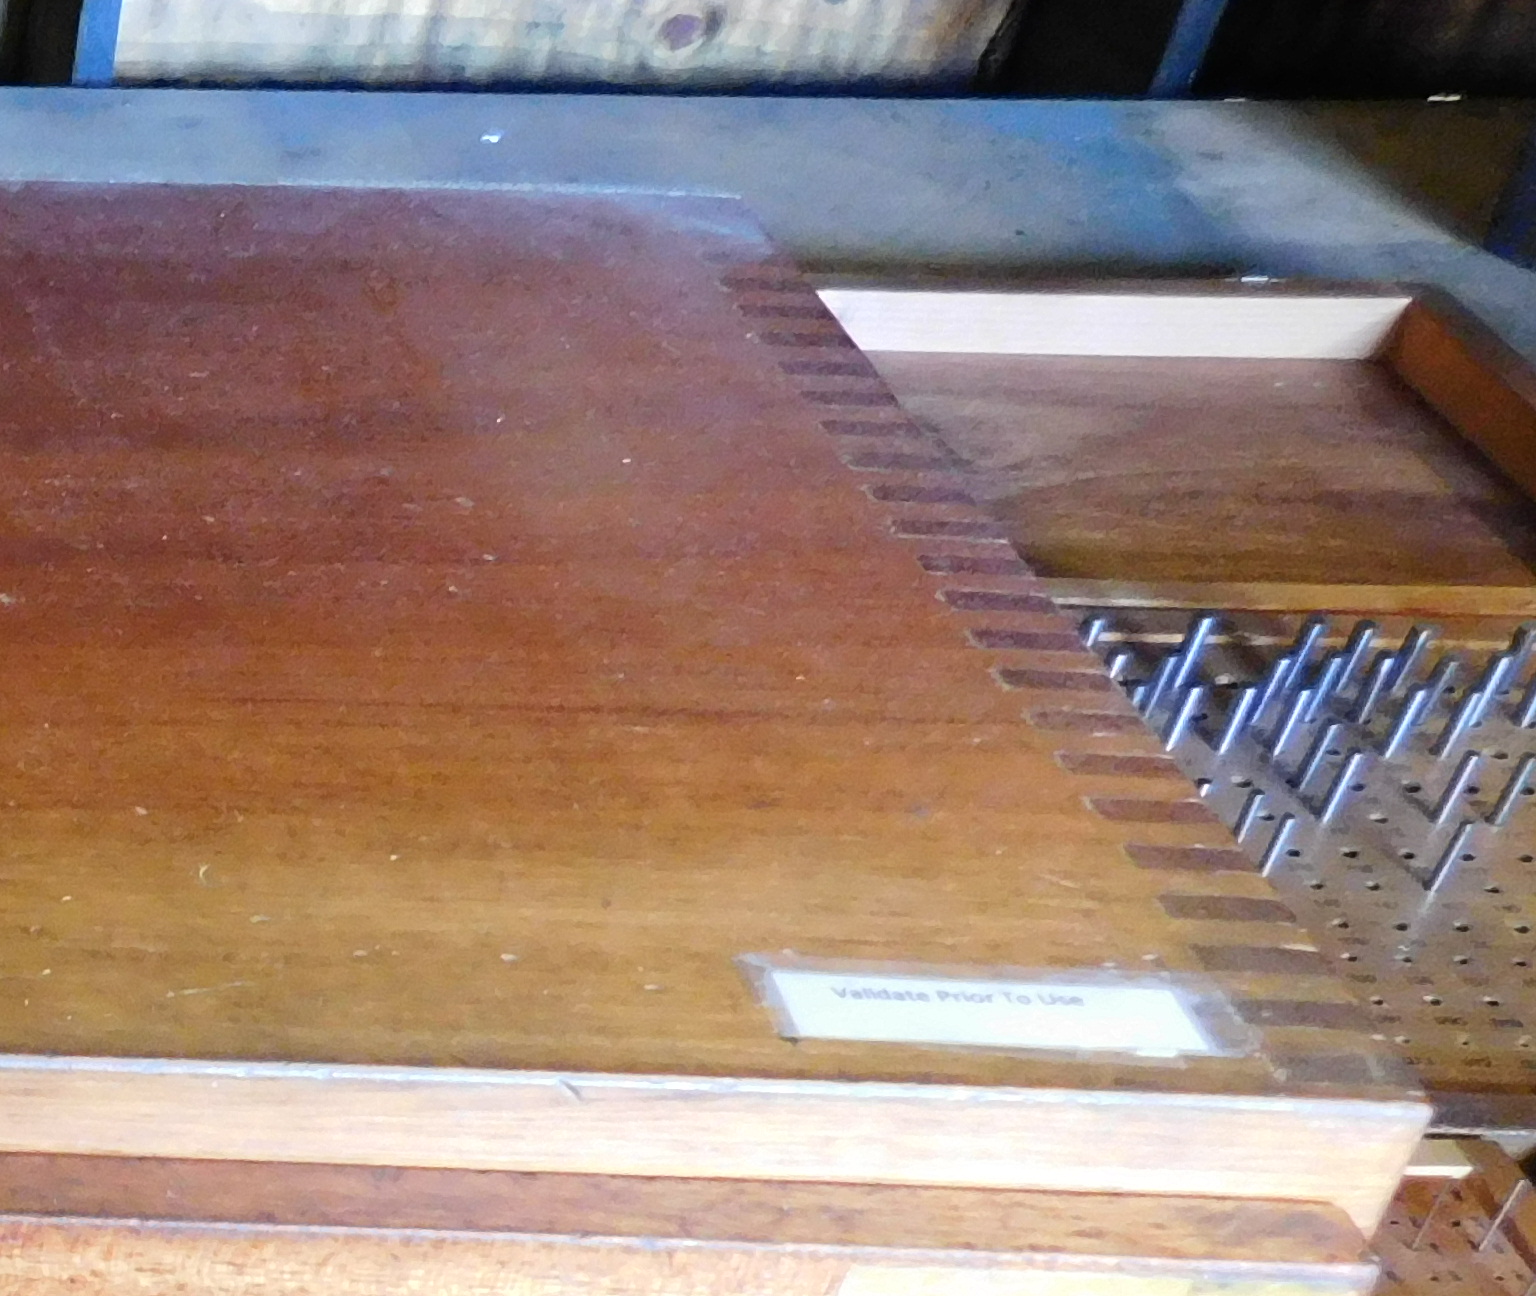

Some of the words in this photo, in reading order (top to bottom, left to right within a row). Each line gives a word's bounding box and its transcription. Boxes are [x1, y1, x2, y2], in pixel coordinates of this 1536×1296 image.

[830, 985, 931, 1003] Validate
[935, 988, 995, 1004] Prior
[1002, 991, 1033, 1006] To
[1037, 992, 1086, 1007] Use
